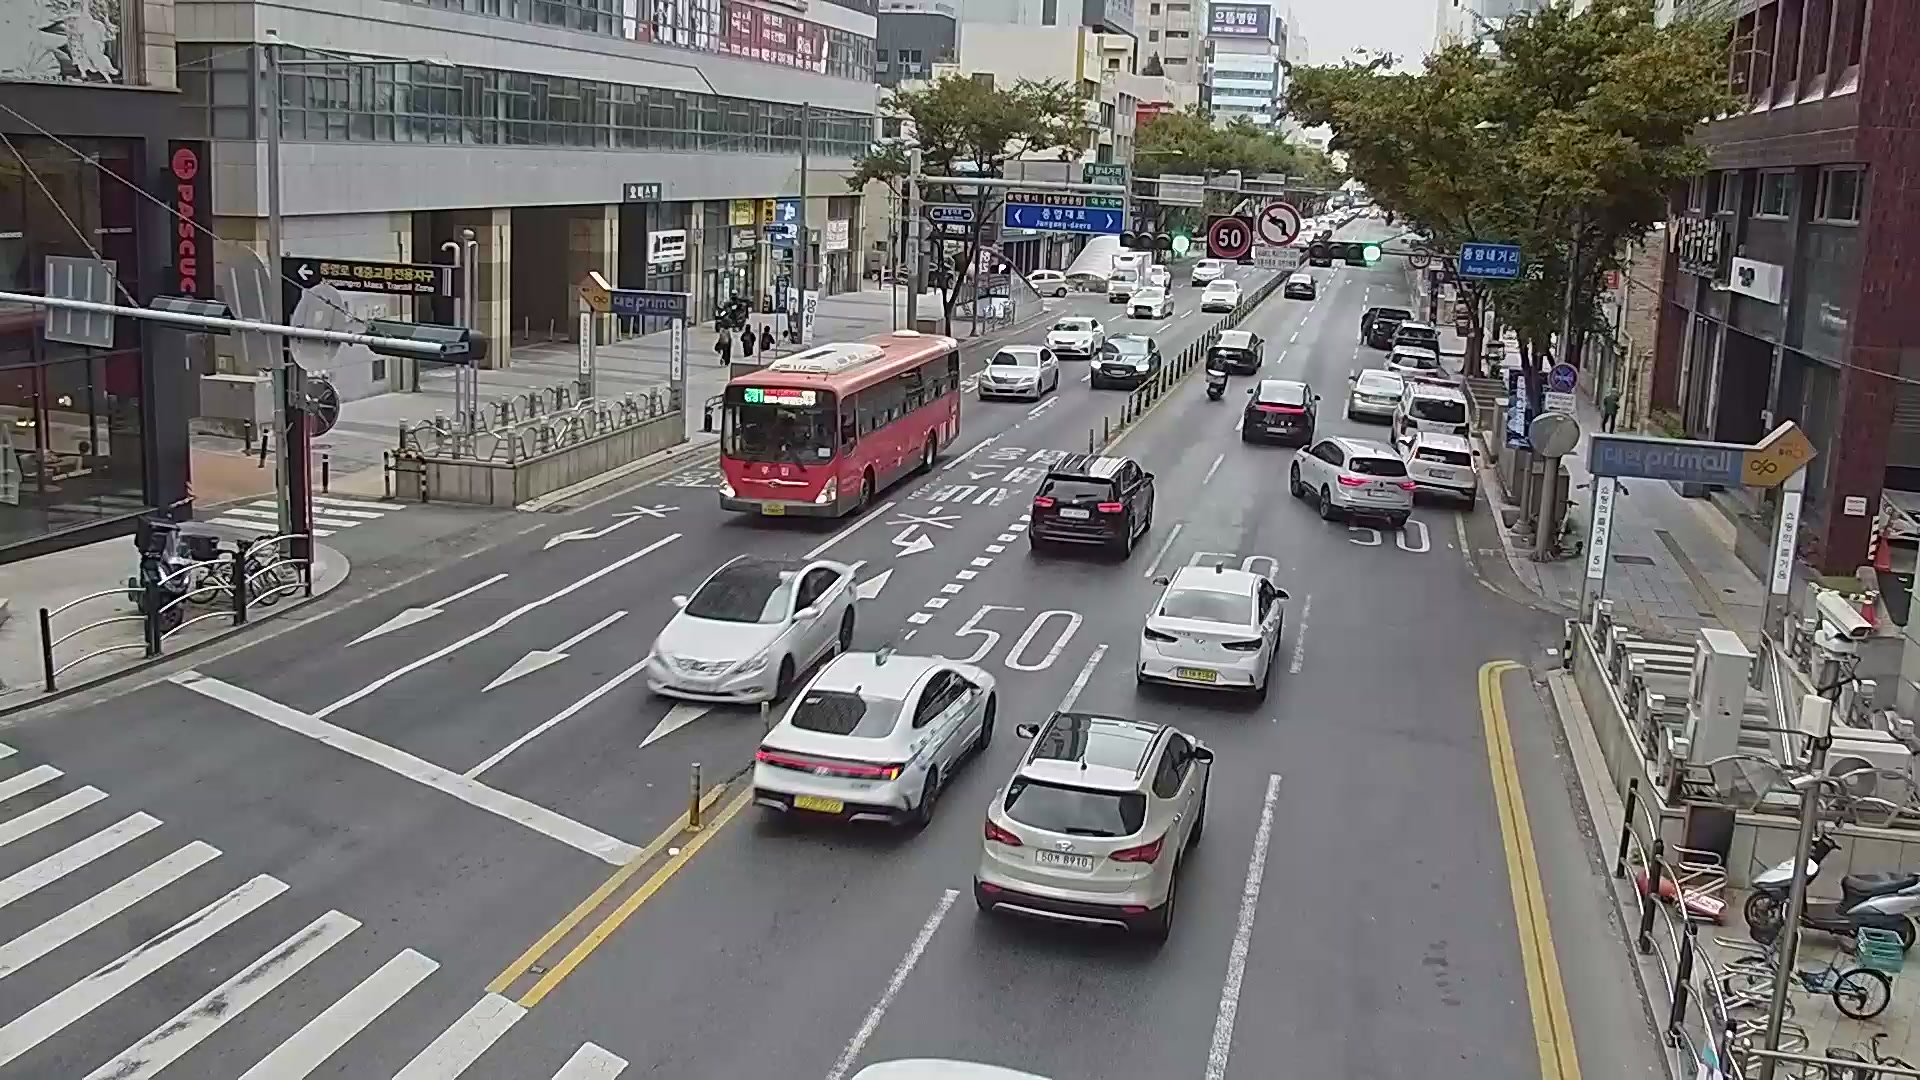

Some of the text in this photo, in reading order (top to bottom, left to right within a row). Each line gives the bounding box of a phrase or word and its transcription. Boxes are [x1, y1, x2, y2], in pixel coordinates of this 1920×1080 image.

[1042, 208, 1085, 221] 중앙대로
[1218, 228, 1242, 248] 50
[1463, 248, 1519, 263] 중앙네거리
[937, 604, 1085, 672] 50
